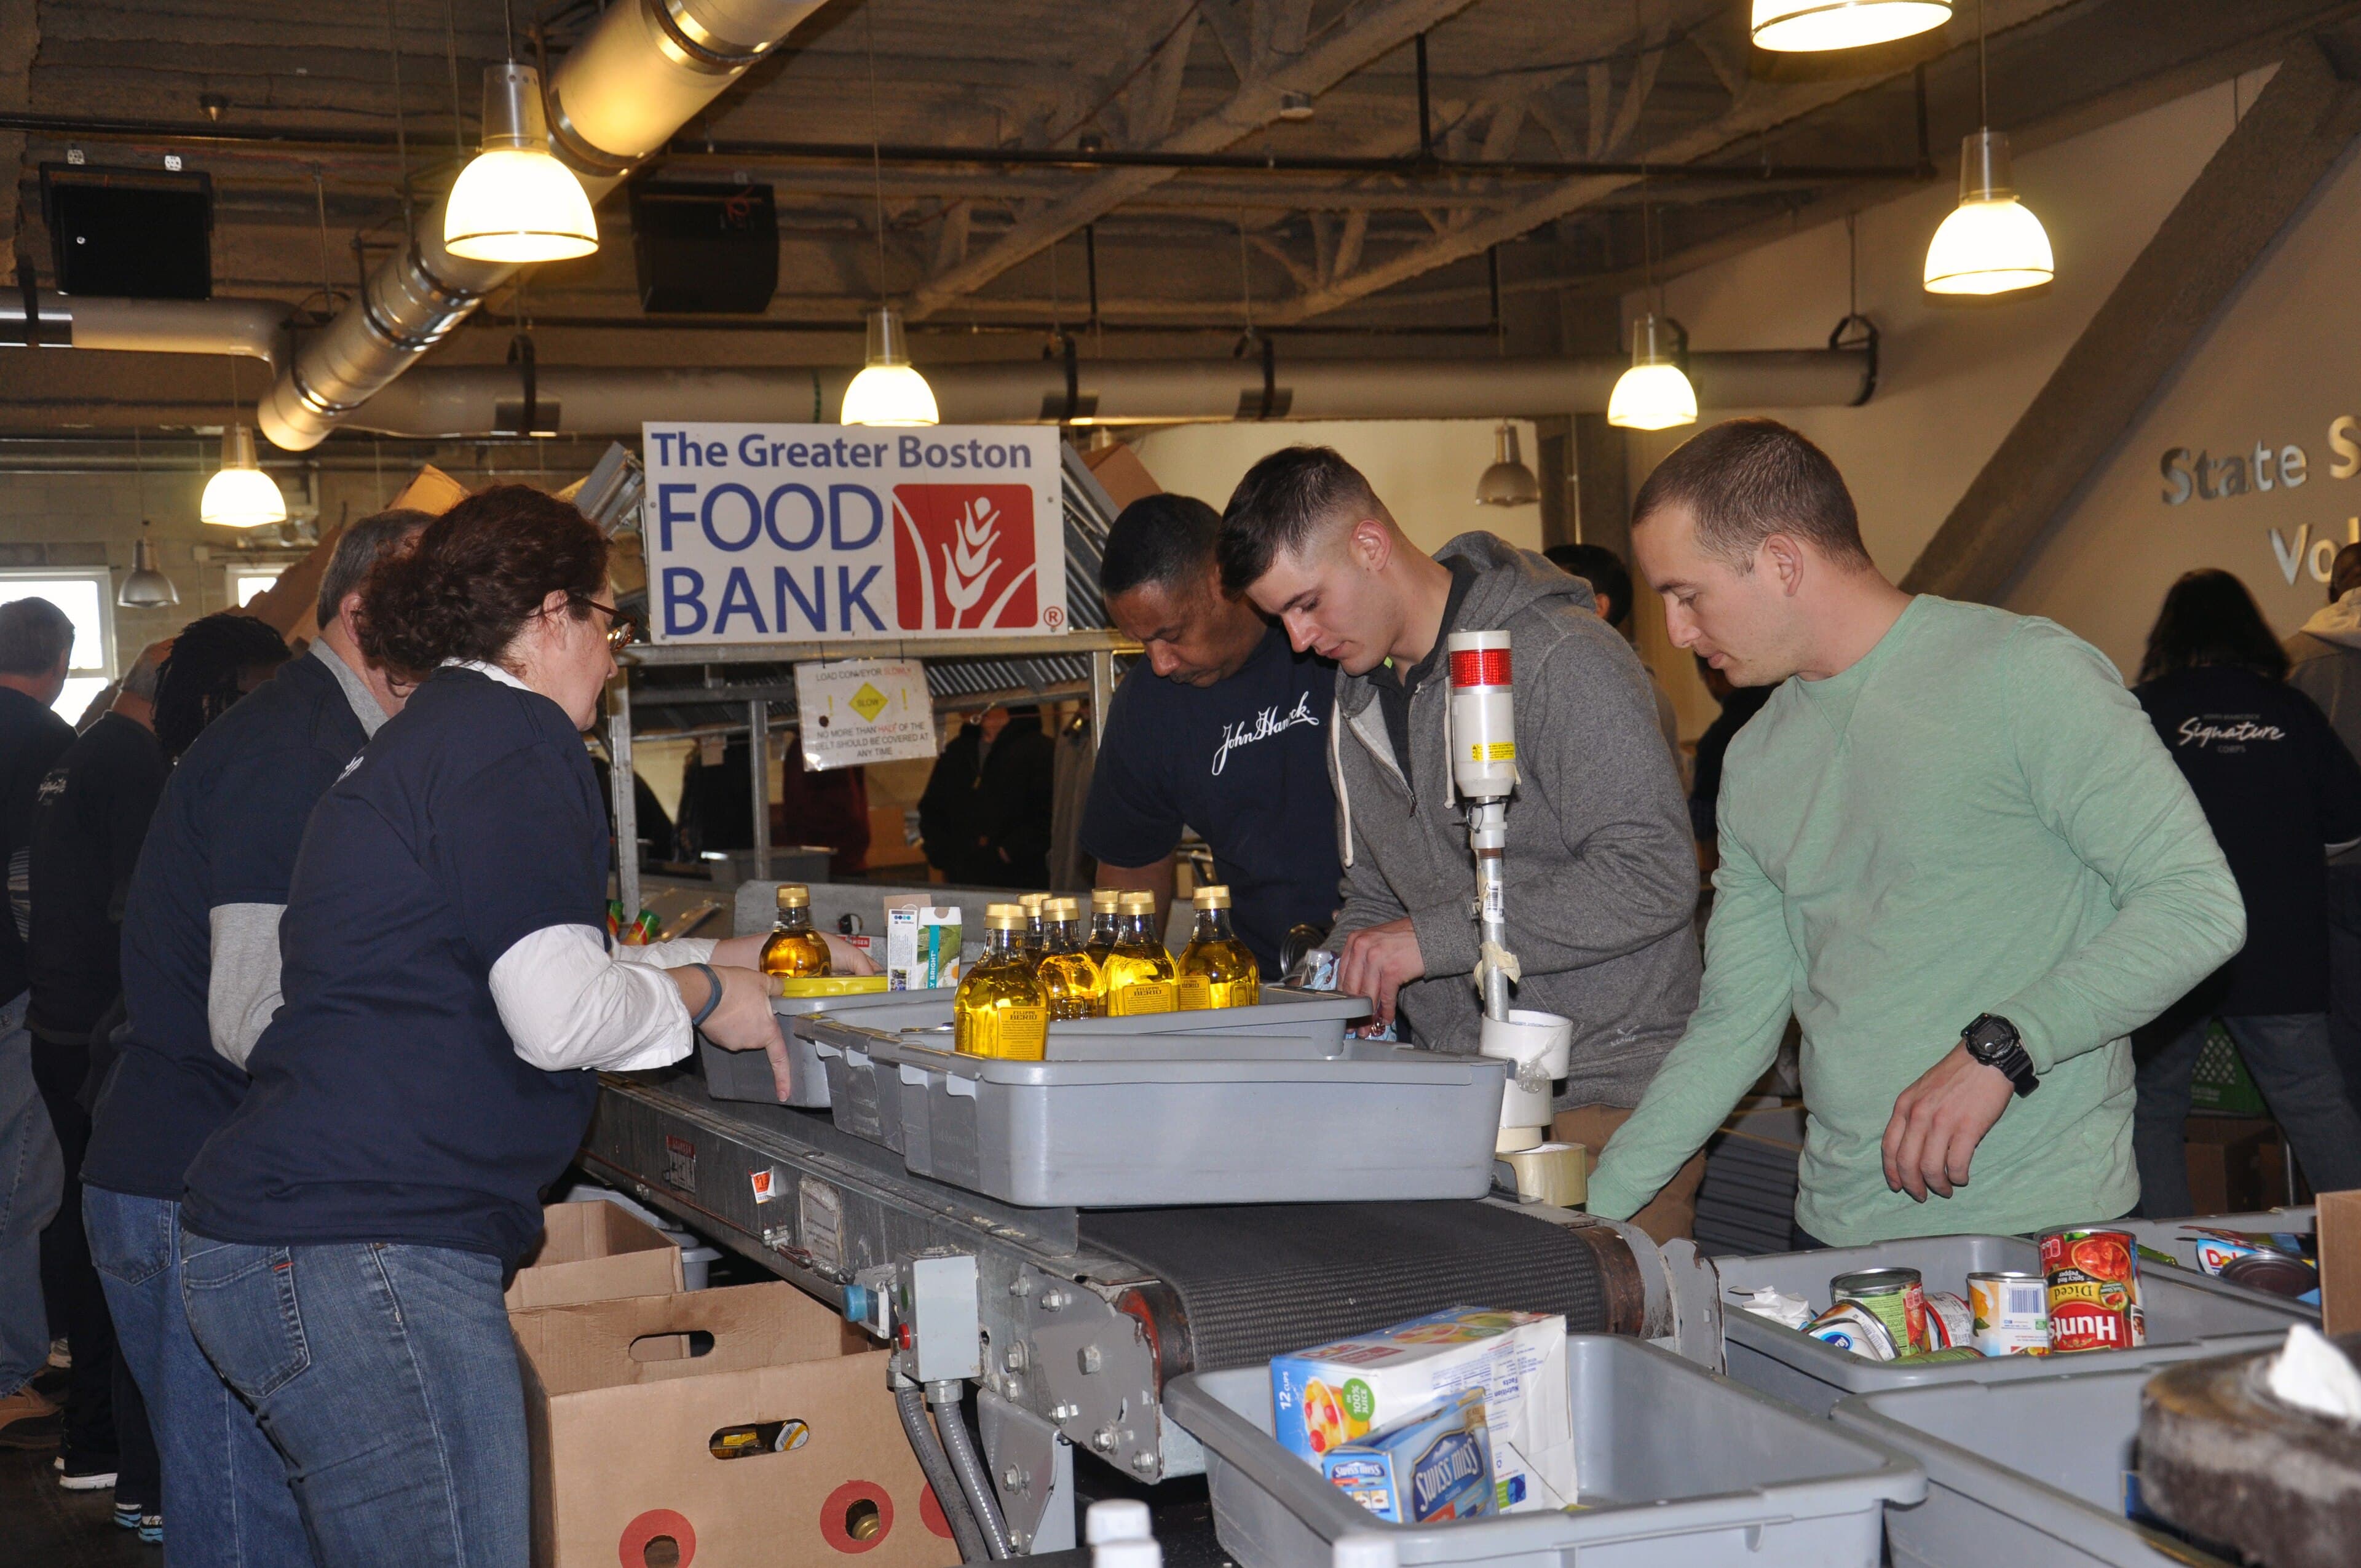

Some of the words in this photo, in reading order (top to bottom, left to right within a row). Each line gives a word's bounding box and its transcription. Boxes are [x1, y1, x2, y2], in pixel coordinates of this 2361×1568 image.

[651, 432, 728, 467] The
[738, 434, 888, 467] Greater
[898, 435, 1032, 469] Boston
[2160, 440, 2307, 505] State
[658, 482, 884, 552] FOOD
[662, 565, 887, 636] BANK
[816, 671, 837, 681] LOAD
[839, 668, 882, 679] CONVEYOR
[856, 698, 879, 708] SLOW
[817, 731, 829, 739] NO
[831, 727, 854, 737] MORE
[856, 726, 877, 735] THAN
[898, 723, 909, 732] OF
[911, 721, 925, 731] THE
[2178, 716, 2285, 748] Signature
[836, 738, 868, 748] SHOULD
[881, 733, 919, 744] COVERED
[919, 732, 929, 740] AT
[856, 749, 873, 758] ANY
[874, 746, 893, 756] TIME
[2054, 1285, 2093, 1299] Diced
[1503, 1377, 1519, 1386] Facts
[1278, 1391, 1292, 1411] 12
[1351, 1385, 1361, 1414] 100%
[1360, 1388, 1369, 1414] JUICE
[1493, 1385, 1520, 1398] Nutrition
